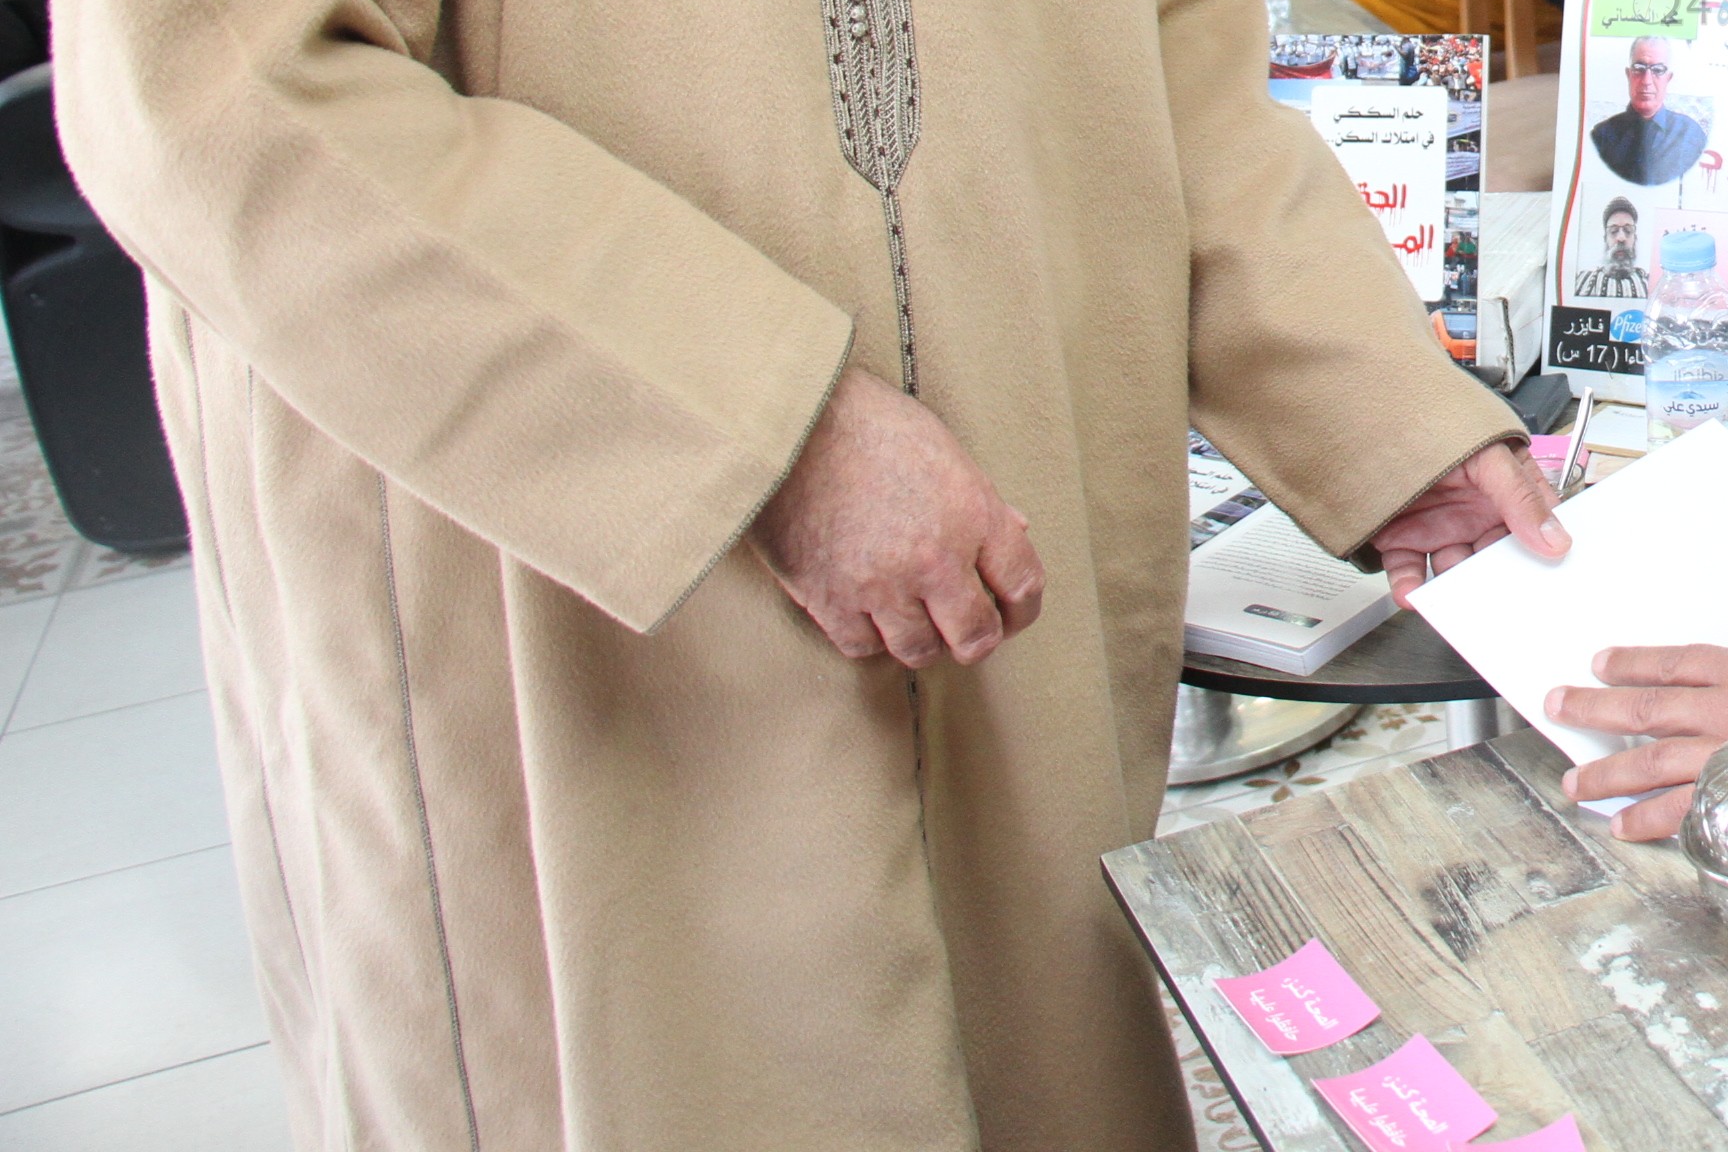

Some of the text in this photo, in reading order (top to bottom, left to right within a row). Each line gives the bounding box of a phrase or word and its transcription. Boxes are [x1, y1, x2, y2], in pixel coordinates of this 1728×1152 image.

[1333, 107, 1424, 123] حلم السككي
[1381, 131, 1419, 145] امتلاك
[1421, 131, 1435, 149] في
[1563, 316, 1605, 337] فايزر
[1663, 400, 1686, 417] علي
[1686, 401, 1720, 417] سيدي
[1249, 988, 1299, 1042] حافظوا عليها
[1304, 996, 1340, 1030] الصحة
[1349, 1087, 1379, 1115] عليها
[1408, 1096, 1449, 1135] الصحة
